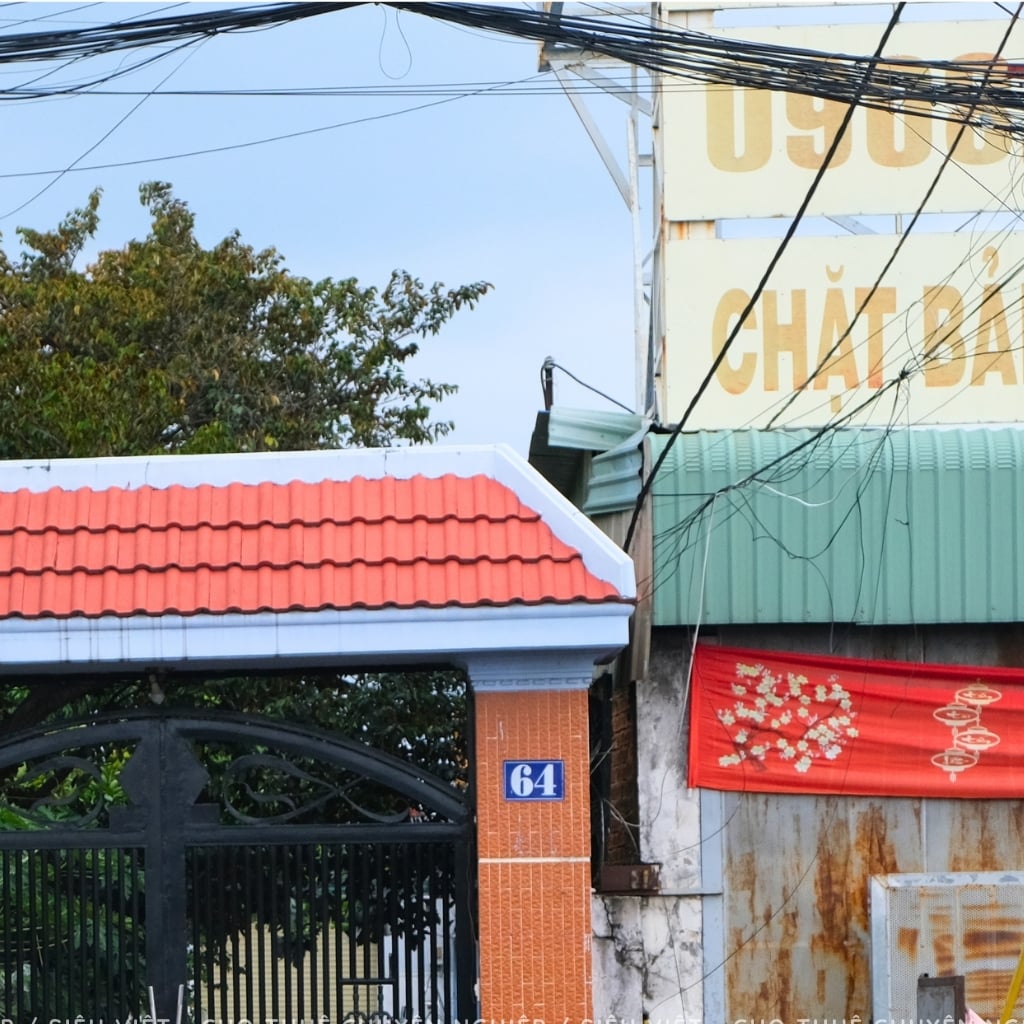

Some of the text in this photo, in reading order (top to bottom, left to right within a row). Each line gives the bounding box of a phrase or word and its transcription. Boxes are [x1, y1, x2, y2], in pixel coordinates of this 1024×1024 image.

[712, 246, 1024, 413] CHẶT BẢ
[510, 763, 557, 797] 64
